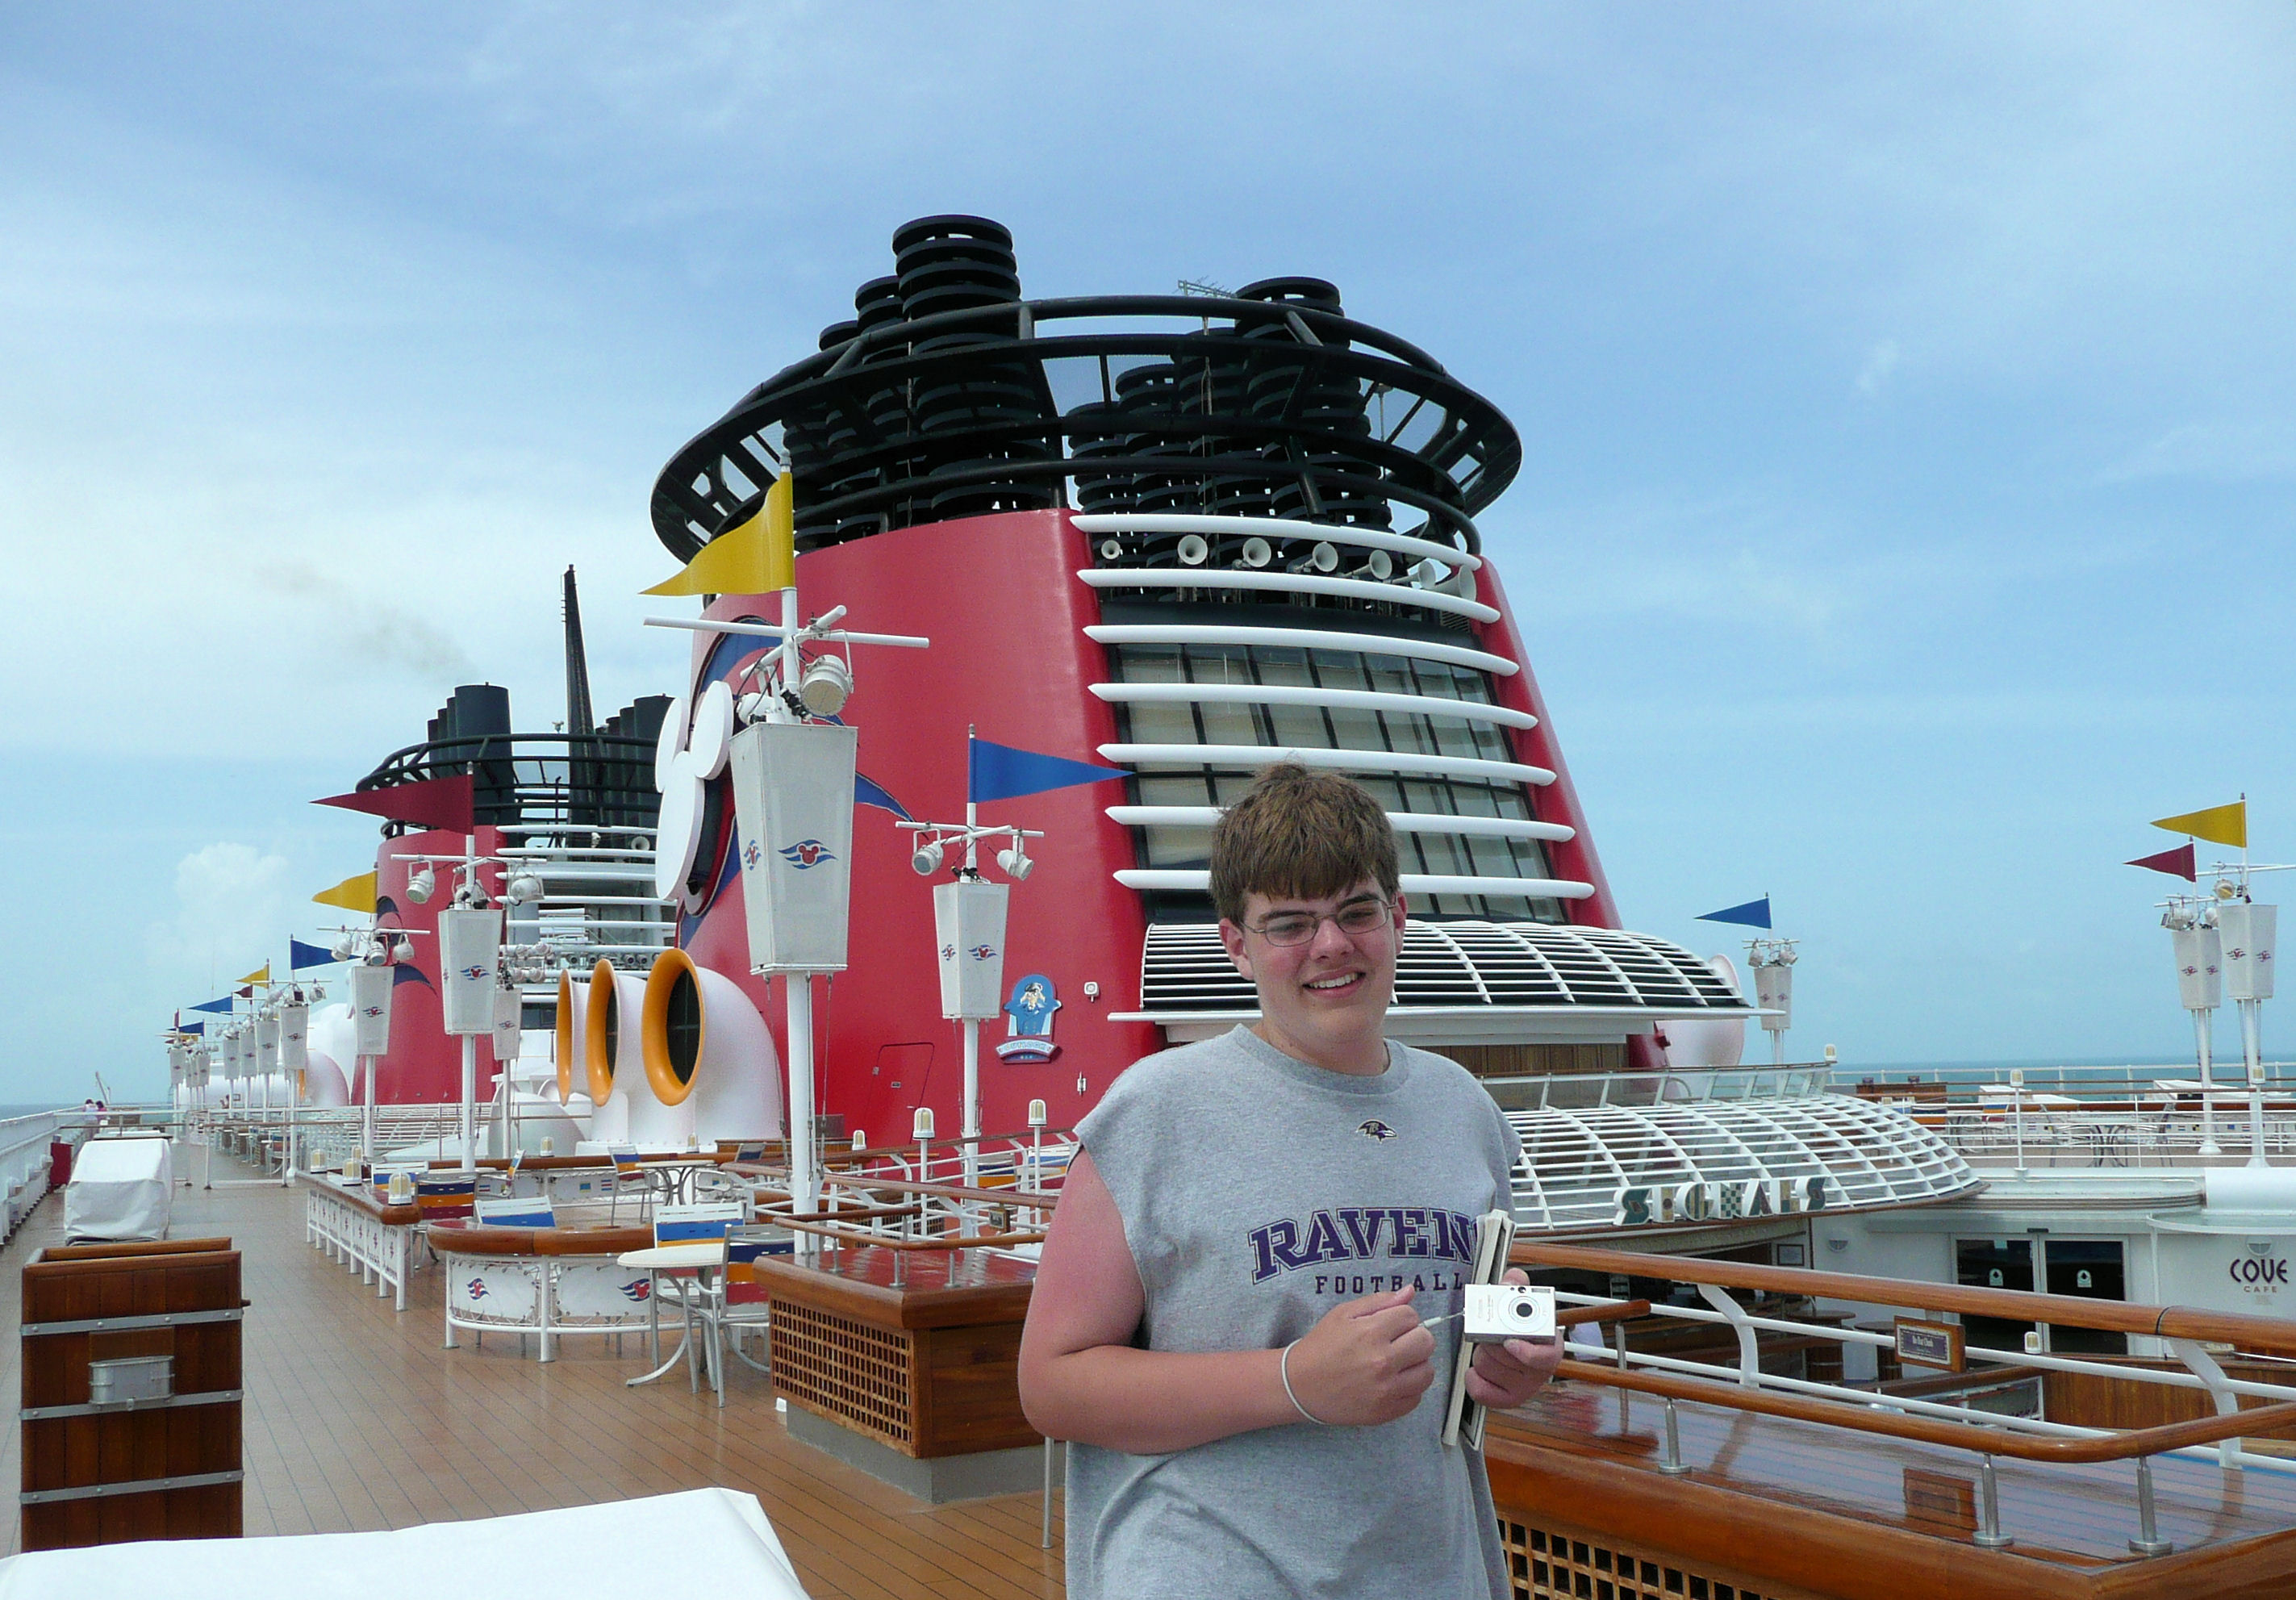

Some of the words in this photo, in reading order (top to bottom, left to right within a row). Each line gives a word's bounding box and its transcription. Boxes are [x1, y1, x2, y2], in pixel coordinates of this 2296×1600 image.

[1613, 1176, 1826, 1226] SIGNALS
[1248, 1207, 1478, 1285] RAVEN
[1315, 1272, 1464, 1294] FOOTBALL
[2230, 1259, 2289, 1284] COVE
[2243, 1285, 2278, 1293] CAFE
